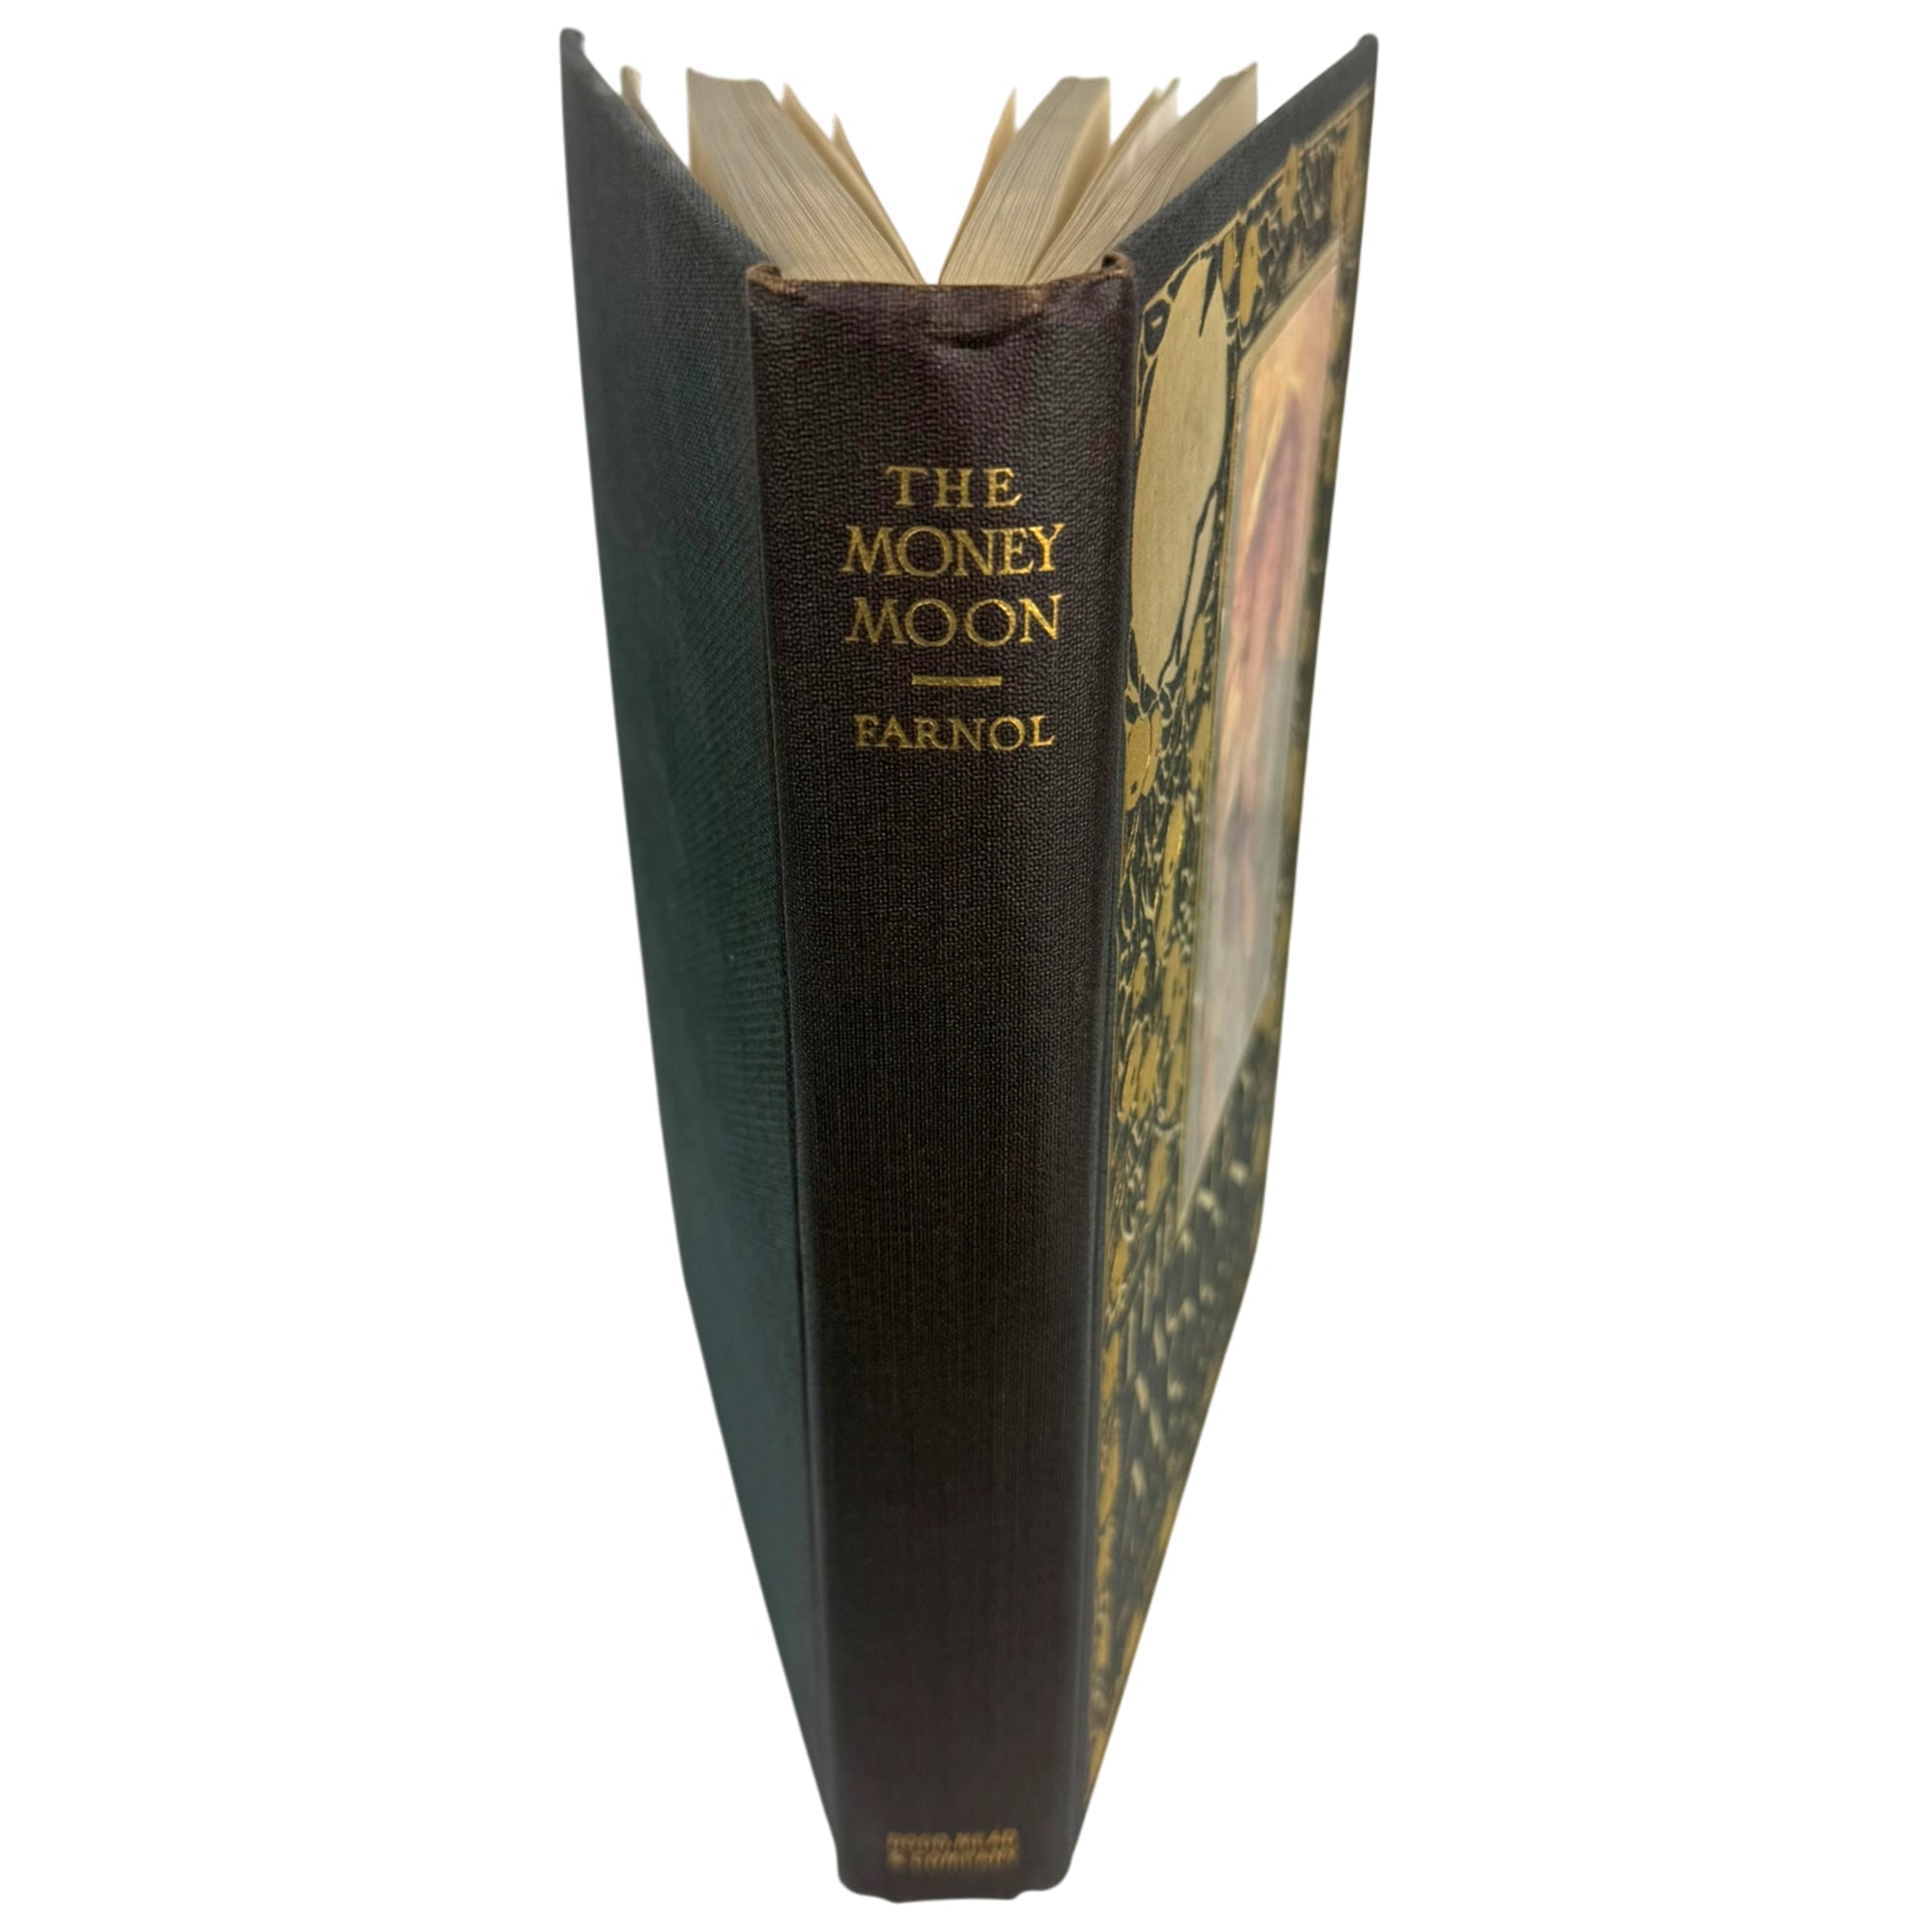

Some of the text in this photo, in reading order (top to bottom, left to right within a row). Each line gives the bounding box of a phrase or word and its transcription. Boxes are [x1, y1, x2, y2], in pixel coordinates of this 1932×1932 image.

[884, 465, 1023, 508] THE
[841, 523, 1065, 578] MONEY
[844, 593, 1063, 648] MOON
[853, 714, 1056, 752] FARNOL
